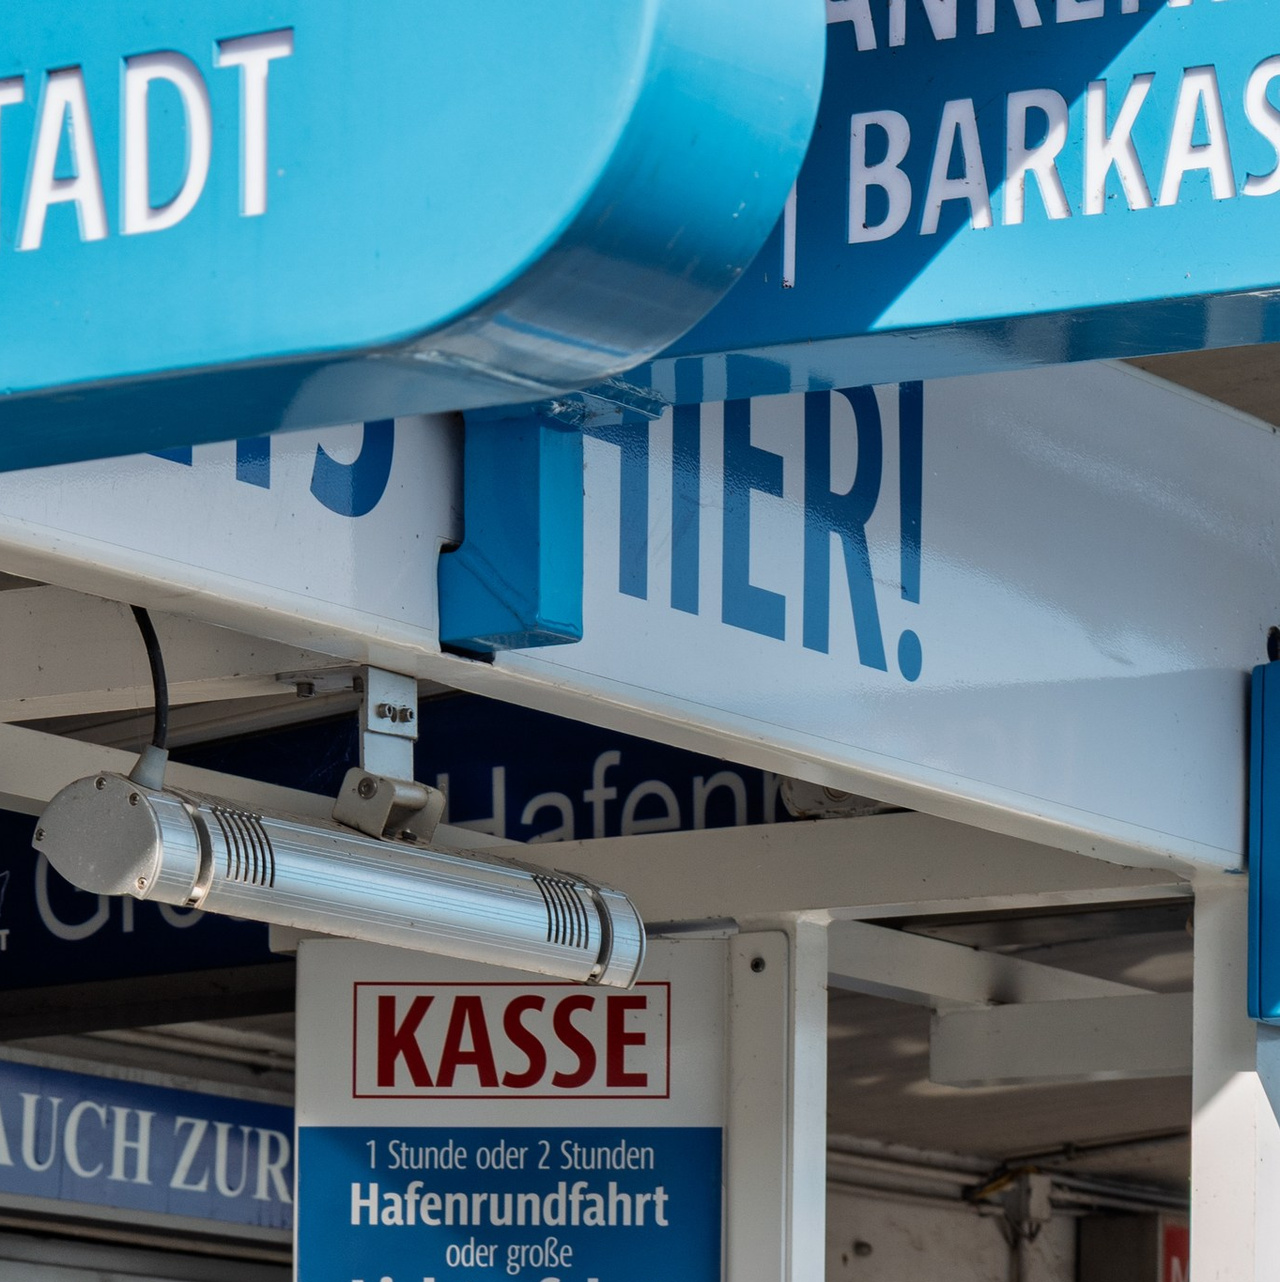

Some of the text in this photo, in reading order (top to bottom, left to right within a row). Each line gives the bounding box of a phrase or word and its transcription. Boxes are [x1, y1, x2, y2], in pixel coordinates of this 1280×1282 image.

[848, 54, 1280, 245] BARKAS
[376, 994, 648, 1090] KASSE
[170, 1115, 293, 1204] ZUR
[366, 1139, 655, 1170] 1 Stunde oder 2 Stunden
[350, 1180, 669, 1228] Hafenrundfahrt
[445, 1236, 573, 1275] oder große
